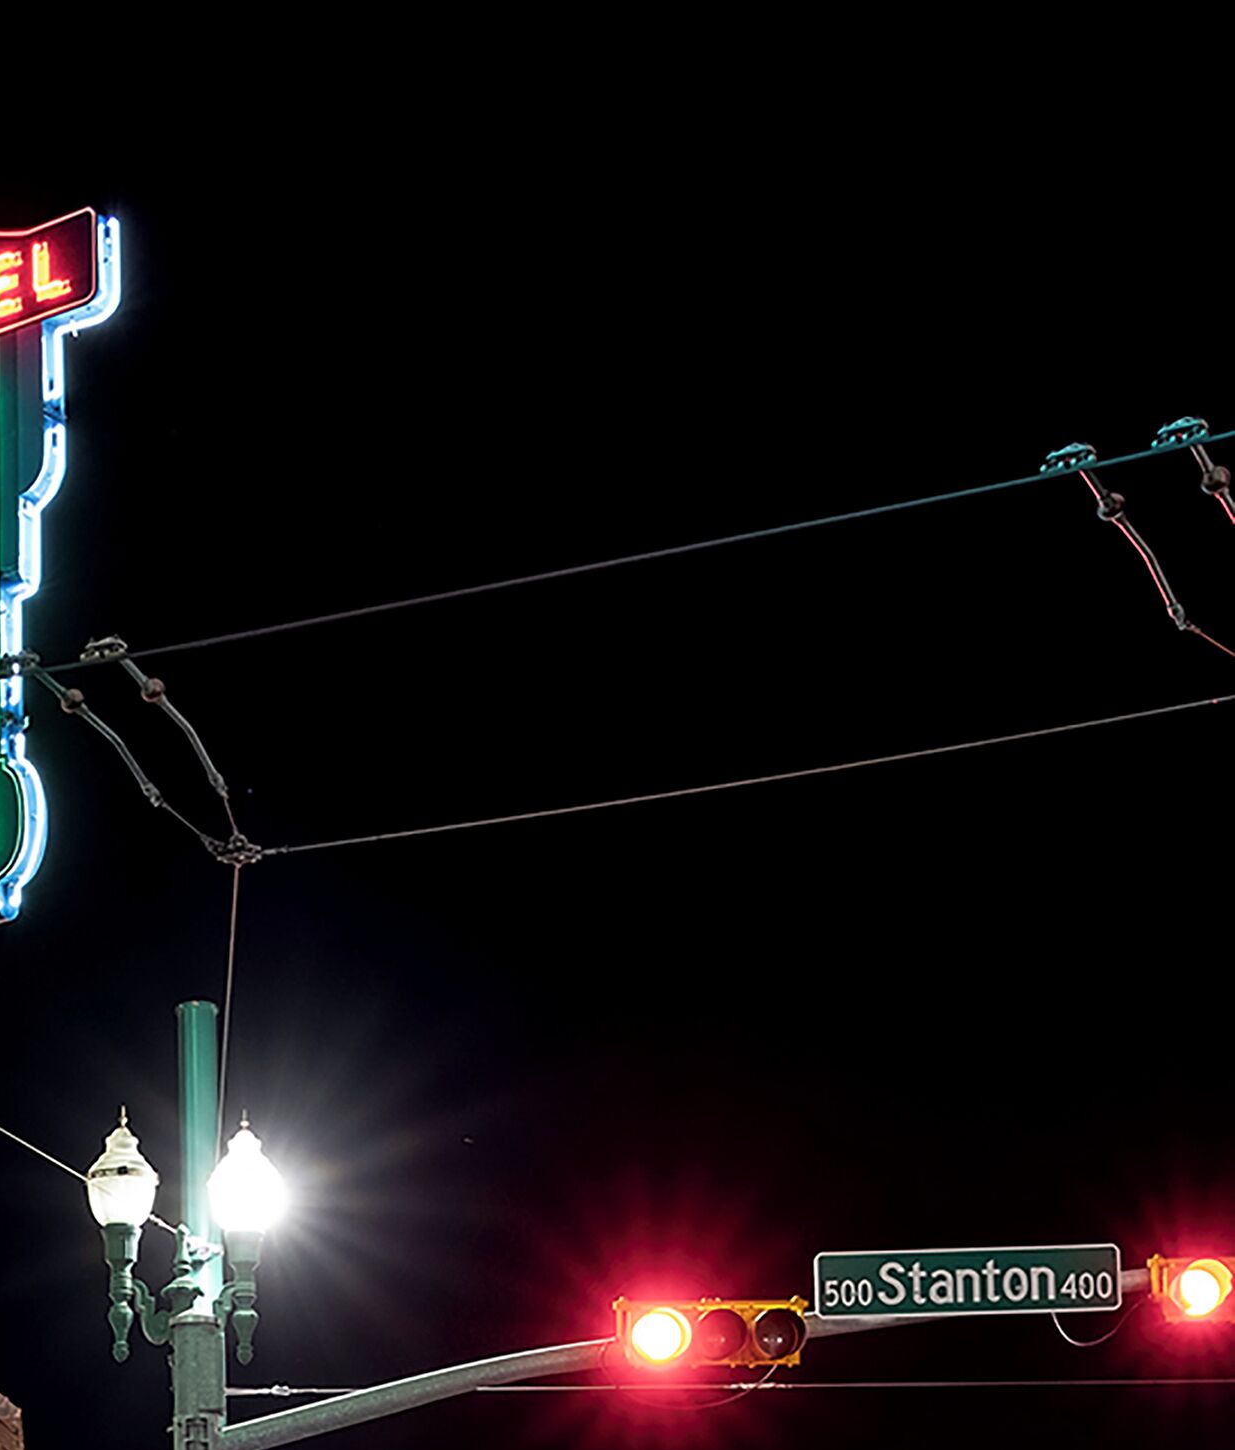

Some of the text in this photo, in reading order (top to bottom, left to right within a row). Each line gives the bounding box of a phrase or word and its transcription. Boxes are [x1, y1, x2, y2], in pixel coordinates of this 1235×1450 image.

[824, 1259, 1113, 1307] 500 Stanton 400
